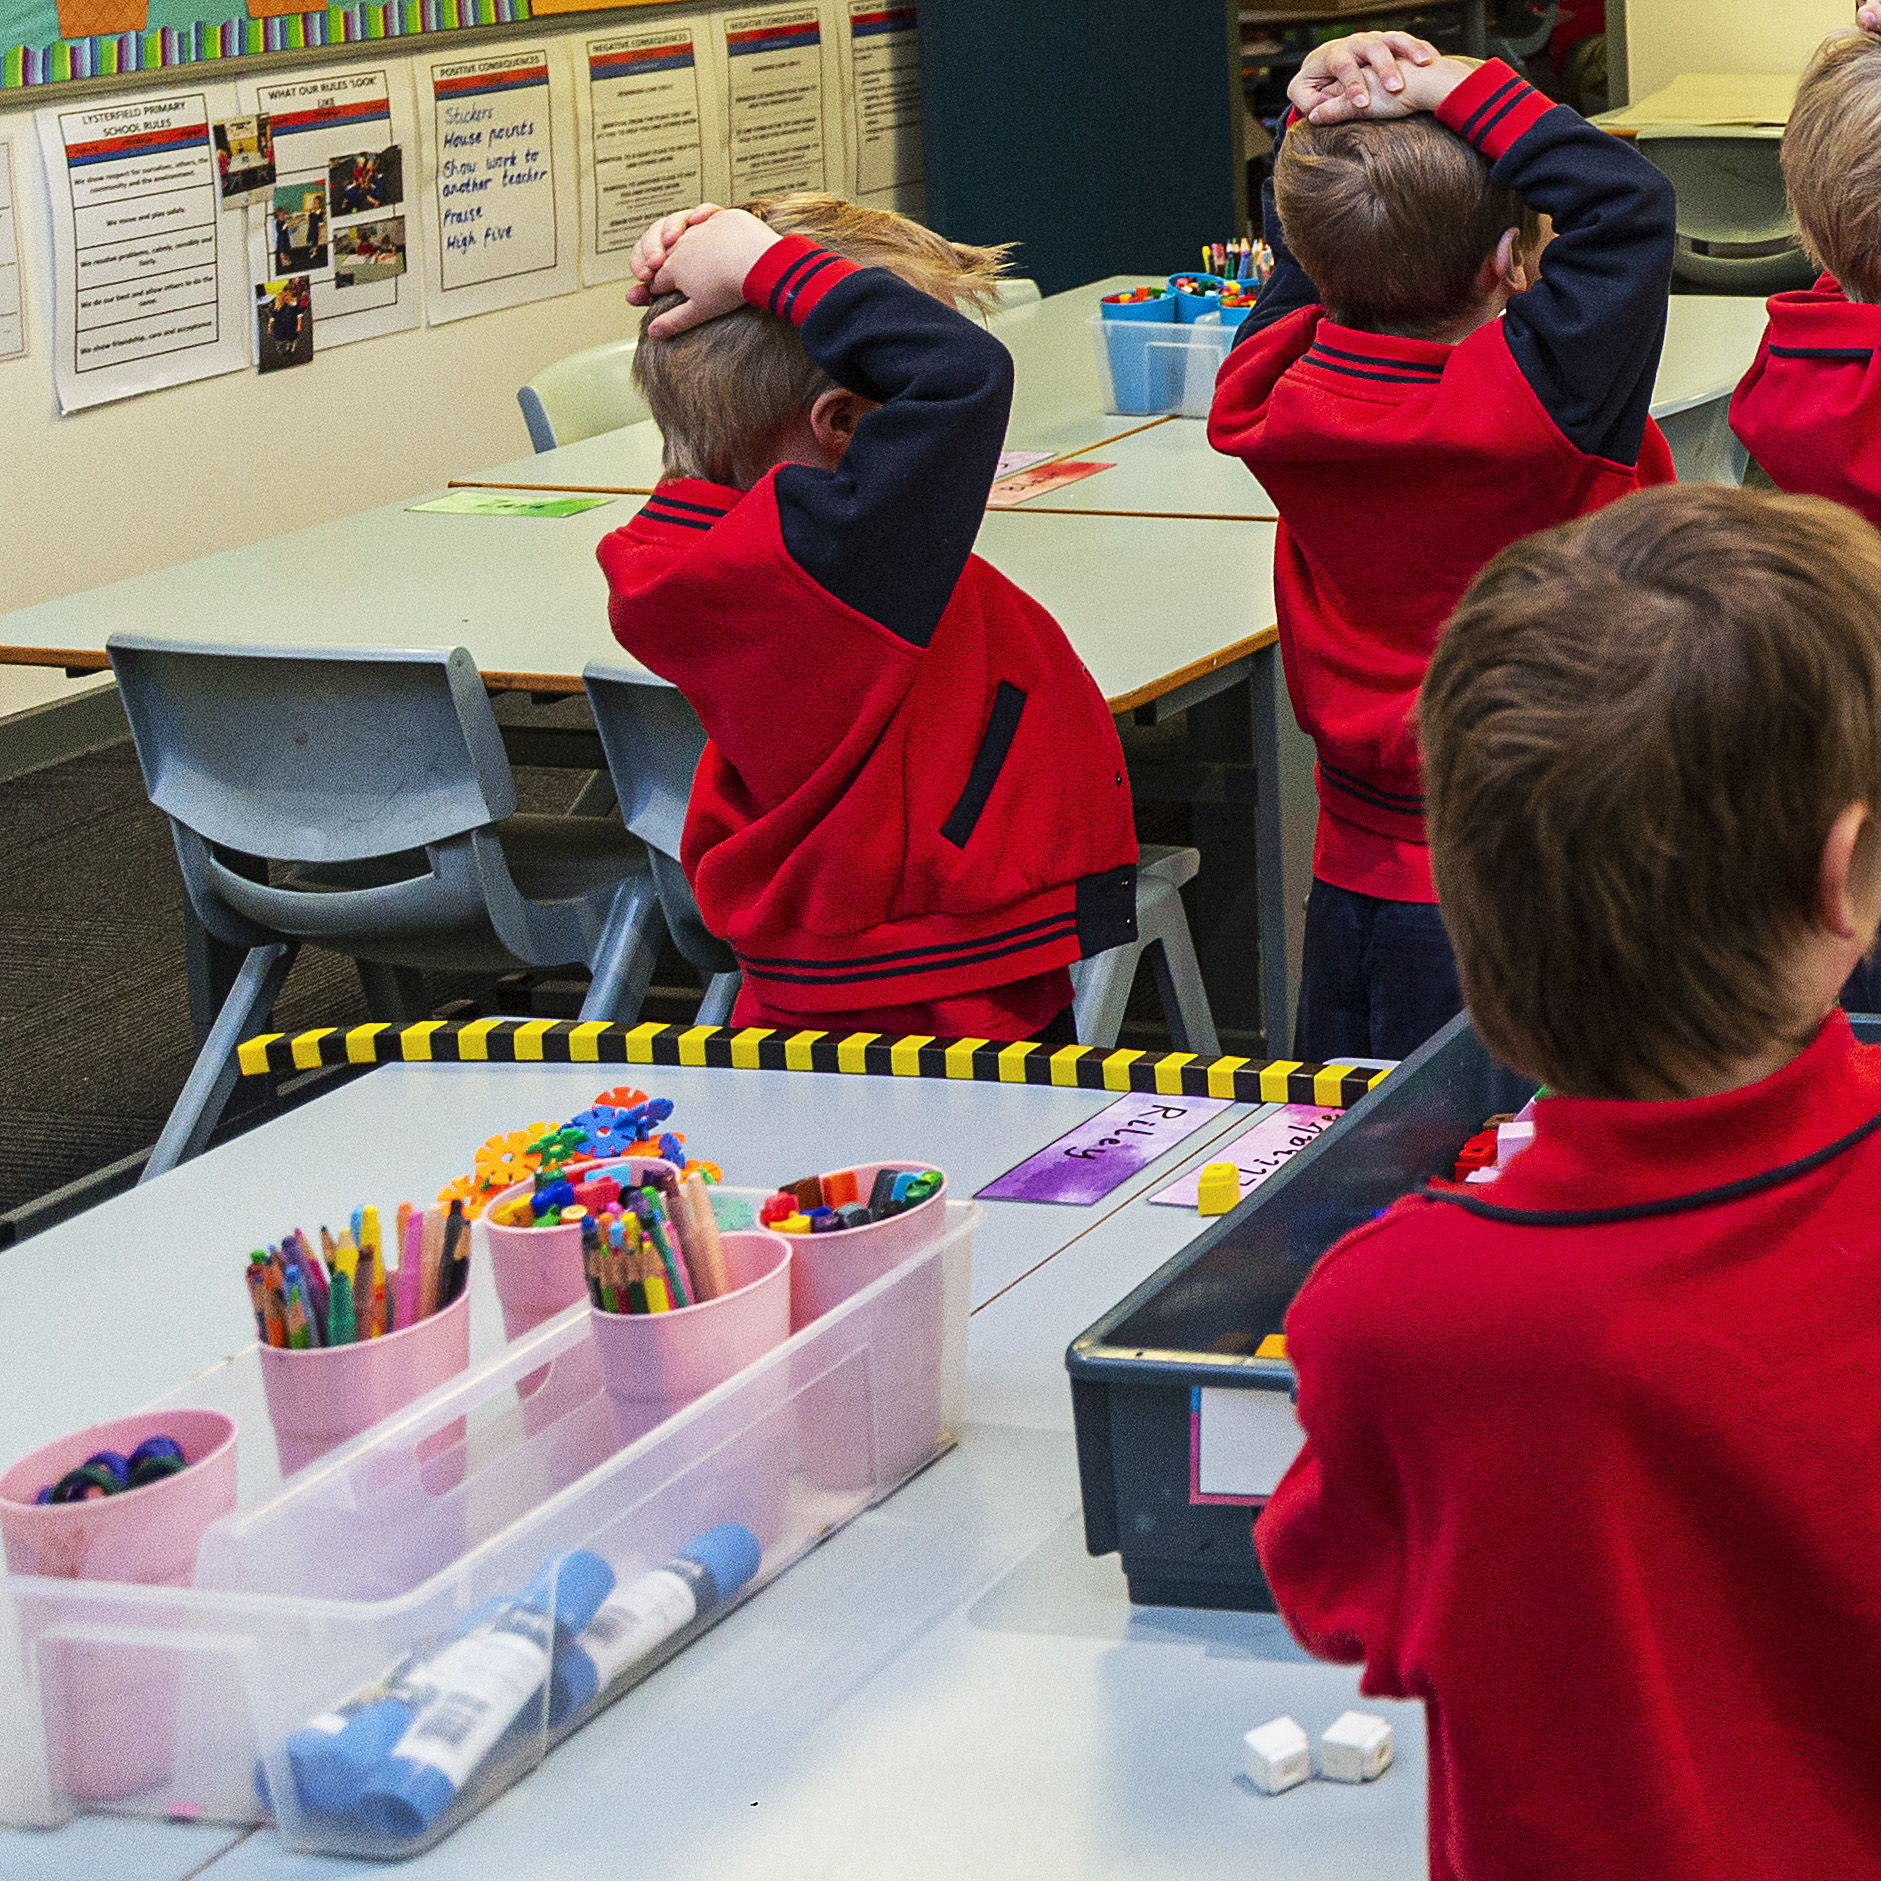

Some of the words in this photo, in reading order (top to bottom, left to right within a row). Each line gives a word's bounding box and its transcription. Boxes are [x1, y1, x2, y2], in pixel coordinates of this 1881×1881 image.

[440, 63, 476, 78] POSITIVE
[267, 87, 298, 100] WHAT
[298, 83, 319, 97] OUR
[321, 81, 345, 94] RULES
[82, 108, 142, 125] LYSTERFIELD
[144, 101, 186, 117] PRIMARY
[445, 102, 495, 124] Stickers
[103, 124, 141, 138] SCHOOL
[143, 118, 172, 132] RULES
[443, 131, 482, 150] House
[488, 121, 534, 147] points
[443, 160, 476, 178] Show
[486, 150, 517, 170] work
[525, 149, 539, 163] to
[443, 178, 492, 198] another
[502, 169, 548, 188] teacher
[443, 206, 483, 226] Praise
[447, 233, 476, 254] High
[1065, 1103, 1187, 1160] Riley
